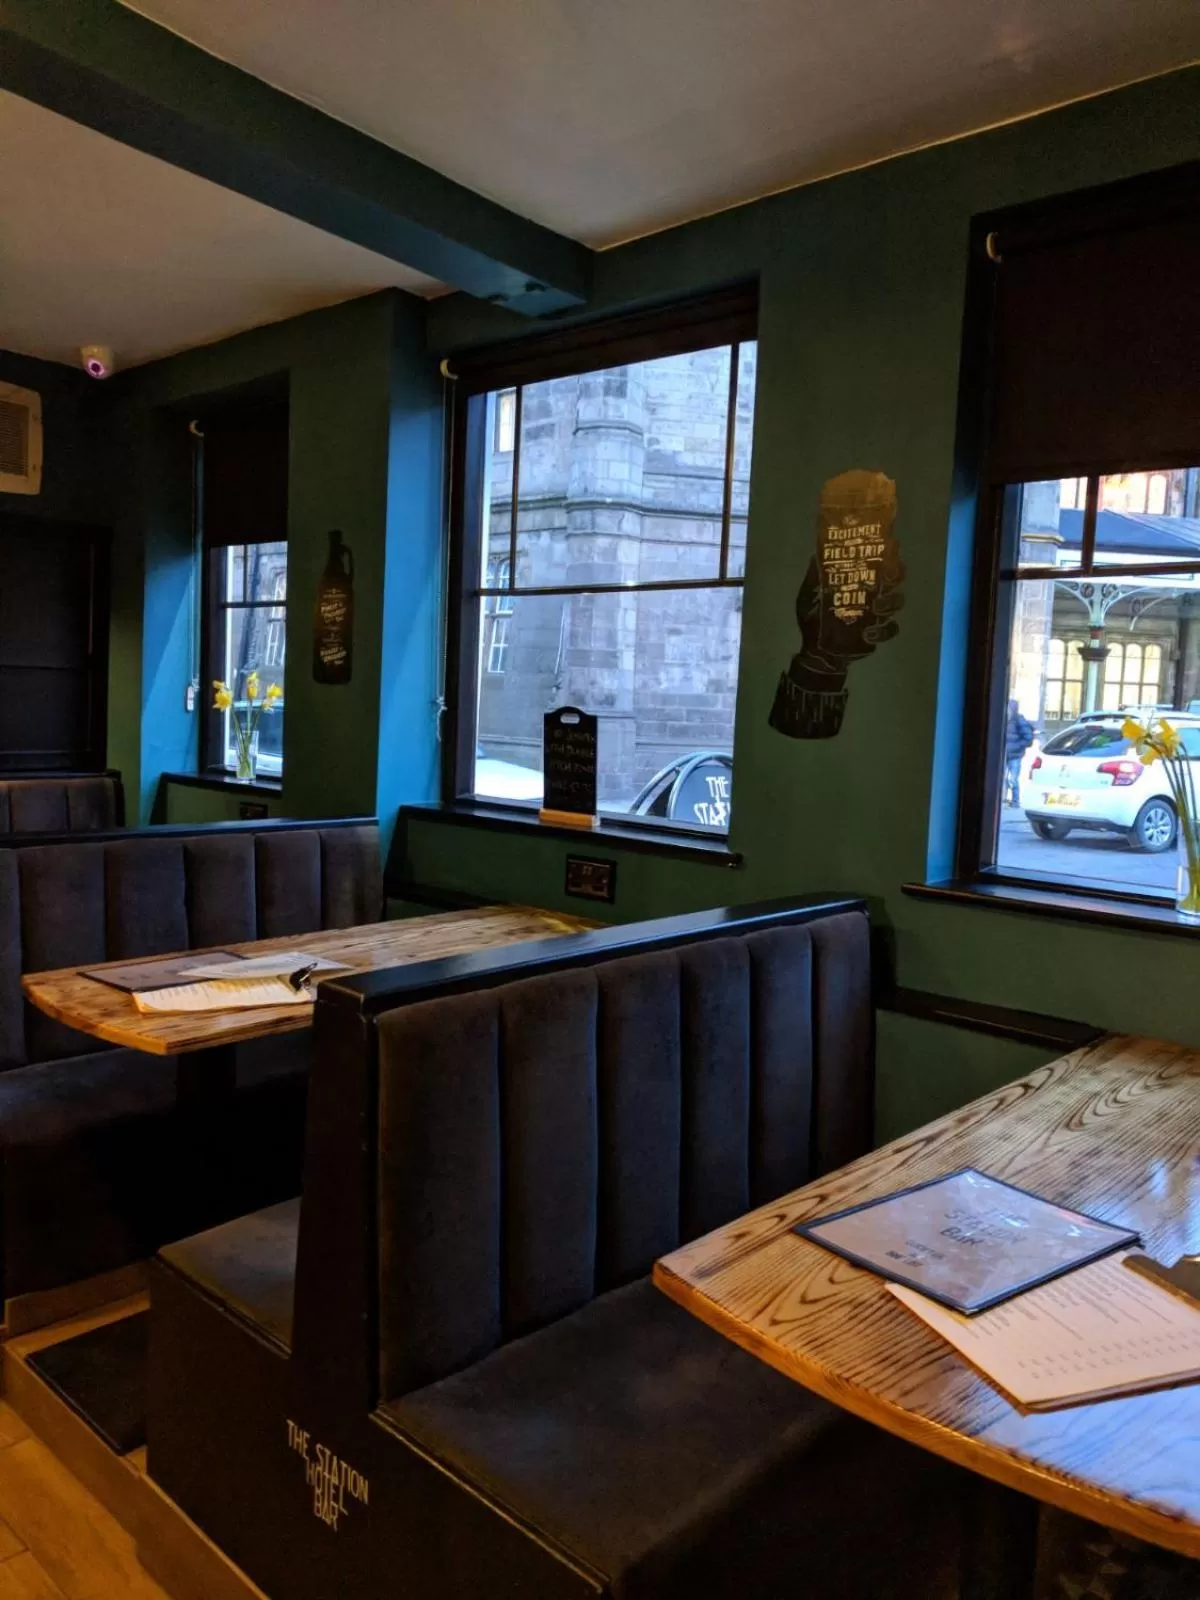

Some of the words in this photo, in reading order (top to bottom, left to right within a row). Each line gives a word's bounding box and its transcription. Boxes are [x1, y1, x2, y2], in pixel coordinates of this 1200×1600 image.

[828, 524, 881, 540] EXCITEMENT
[824, 547, 856, 560] FIELD
[857, 544, 885, 558] TRIP
[828, 573, 844, 585] LET
[848, 569, 876, 582] DOWN
[833, 591, 867, 606] COIN
[705, 776, 729, 798] THE
[286, 1419, 310, 1459] THE
[315, 1443, 368, 1505] STATION
[306, 1459, 348, 1516] HOTEL
[314, 1490, 338, 1532] BAR
